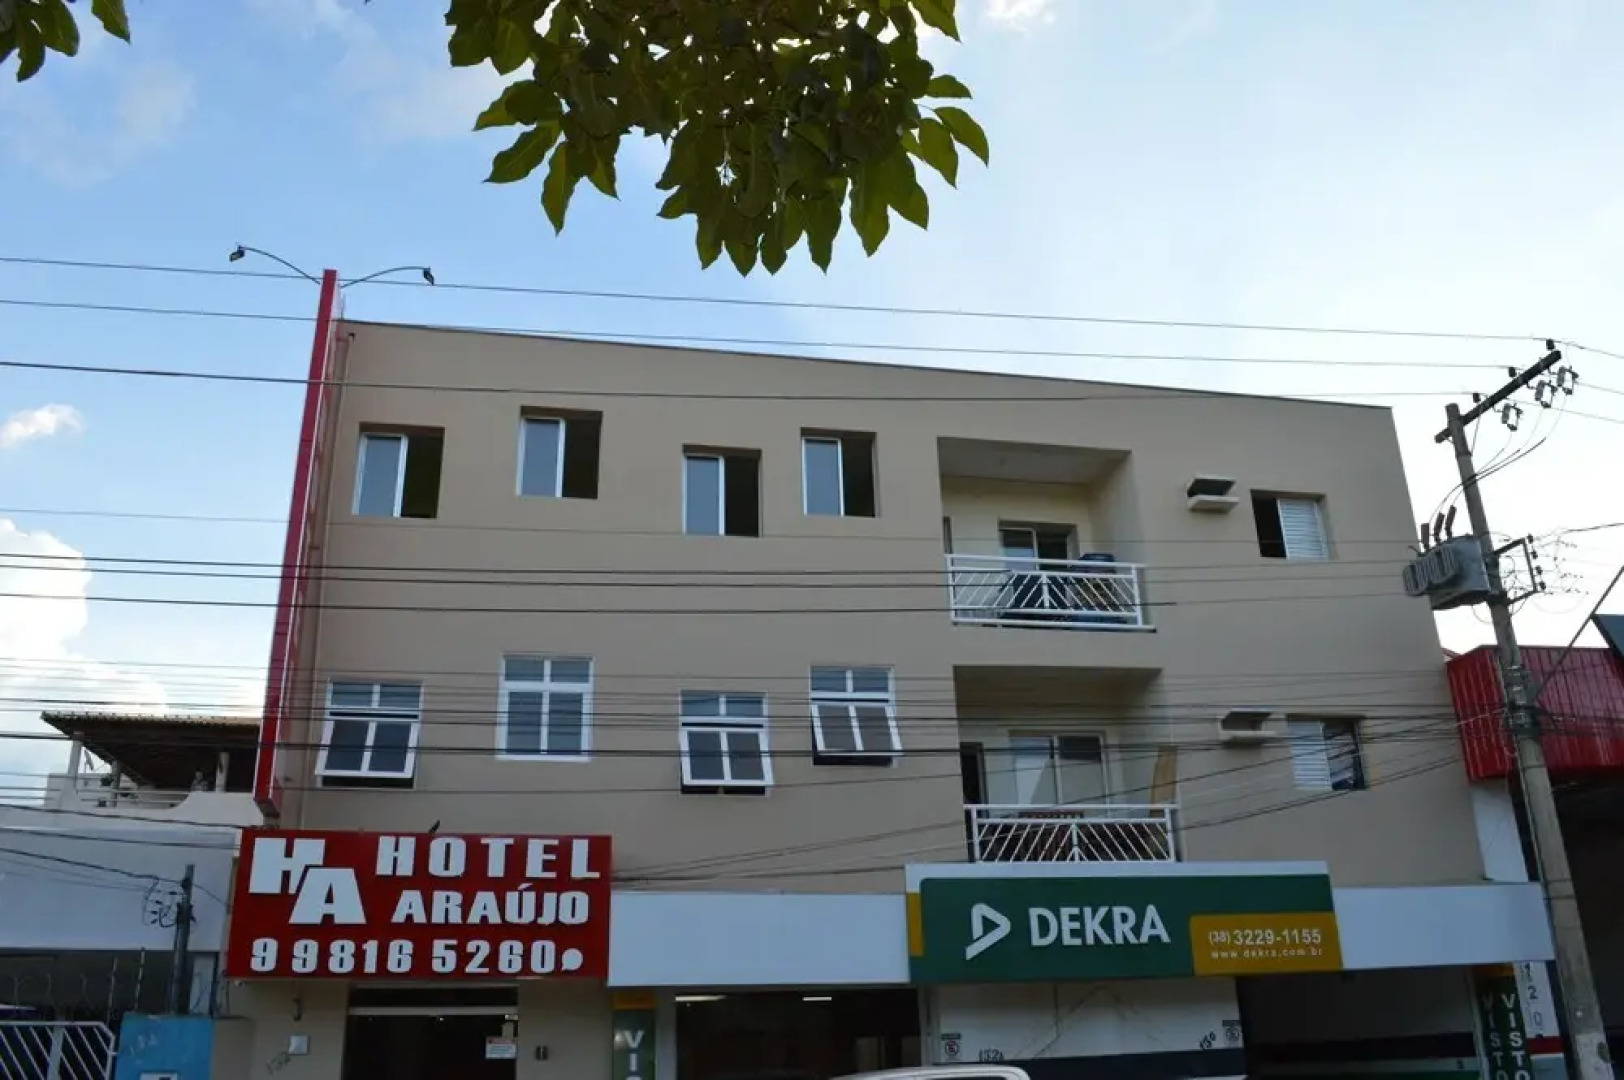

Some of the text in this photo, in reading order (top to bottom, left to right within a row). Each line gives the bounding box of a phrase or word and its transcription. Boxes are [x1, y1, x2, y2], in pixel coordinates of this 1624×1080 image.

[375, 835, 600, 878] HOTEL
[391, 883, 589, 925] ARAÚJO
[1028, 904, 1171, 947] DEKRA
[1208, 928, 1321, 946] (38) 3229-1155
[431, 939, 556, 974] 5260
[623, 1029, 644, 1080] VI
